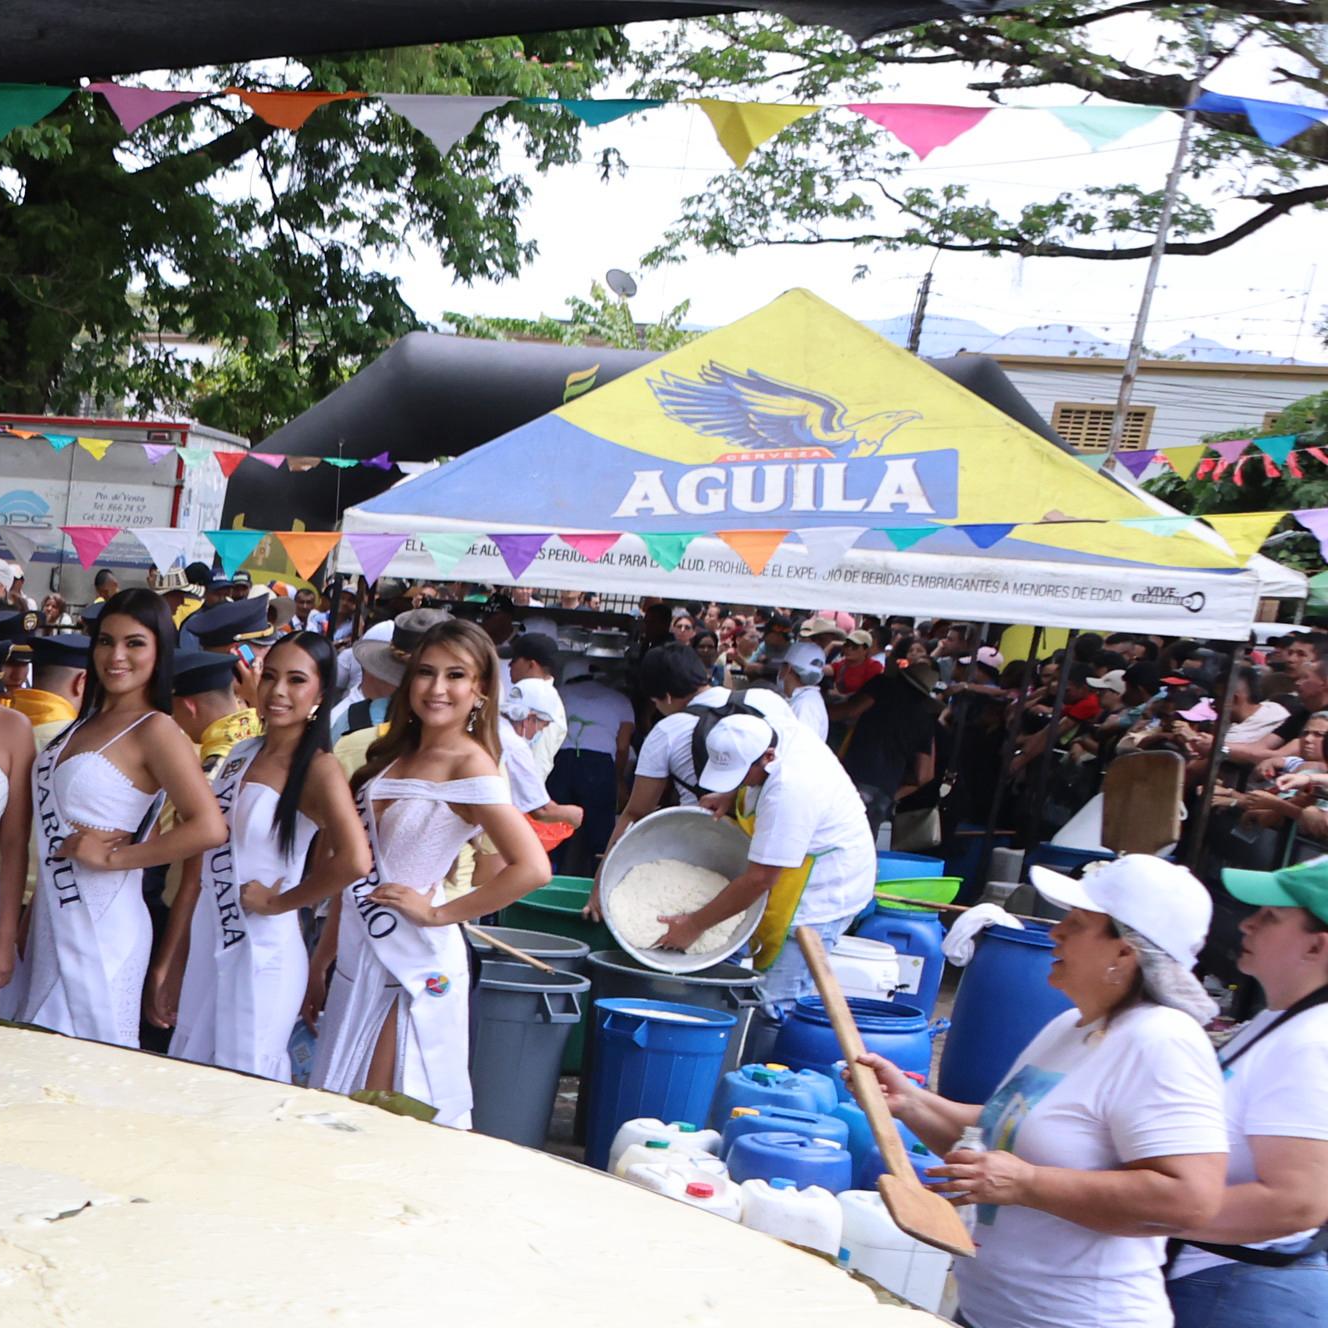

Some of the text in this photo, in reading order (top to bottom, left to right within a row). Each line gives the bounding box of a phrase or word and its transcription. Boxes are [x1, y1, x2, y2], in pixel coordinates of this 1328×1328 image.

[726, 449, 823, 461] CERVEZA
[610, 458, 936, 518] AGUILA
[405, 538, 418, 552] EL
[619, 554, 648, 569] PARA
[771, 564, 784, 578] EL
[844, 570, 859, 583] DE
[861, 572, 909, 587] BEBIDAS
[911, 576, 1000, 594] EMBRIAGANTES
[1002, 581, 1010, 594] A
[1012, 582, 1070, 599] MENORES
[1072, 586, 1088, 600] DE
[36, 756, 82, 909] TARQUI
[215, 782, 247, 950] YUARA
